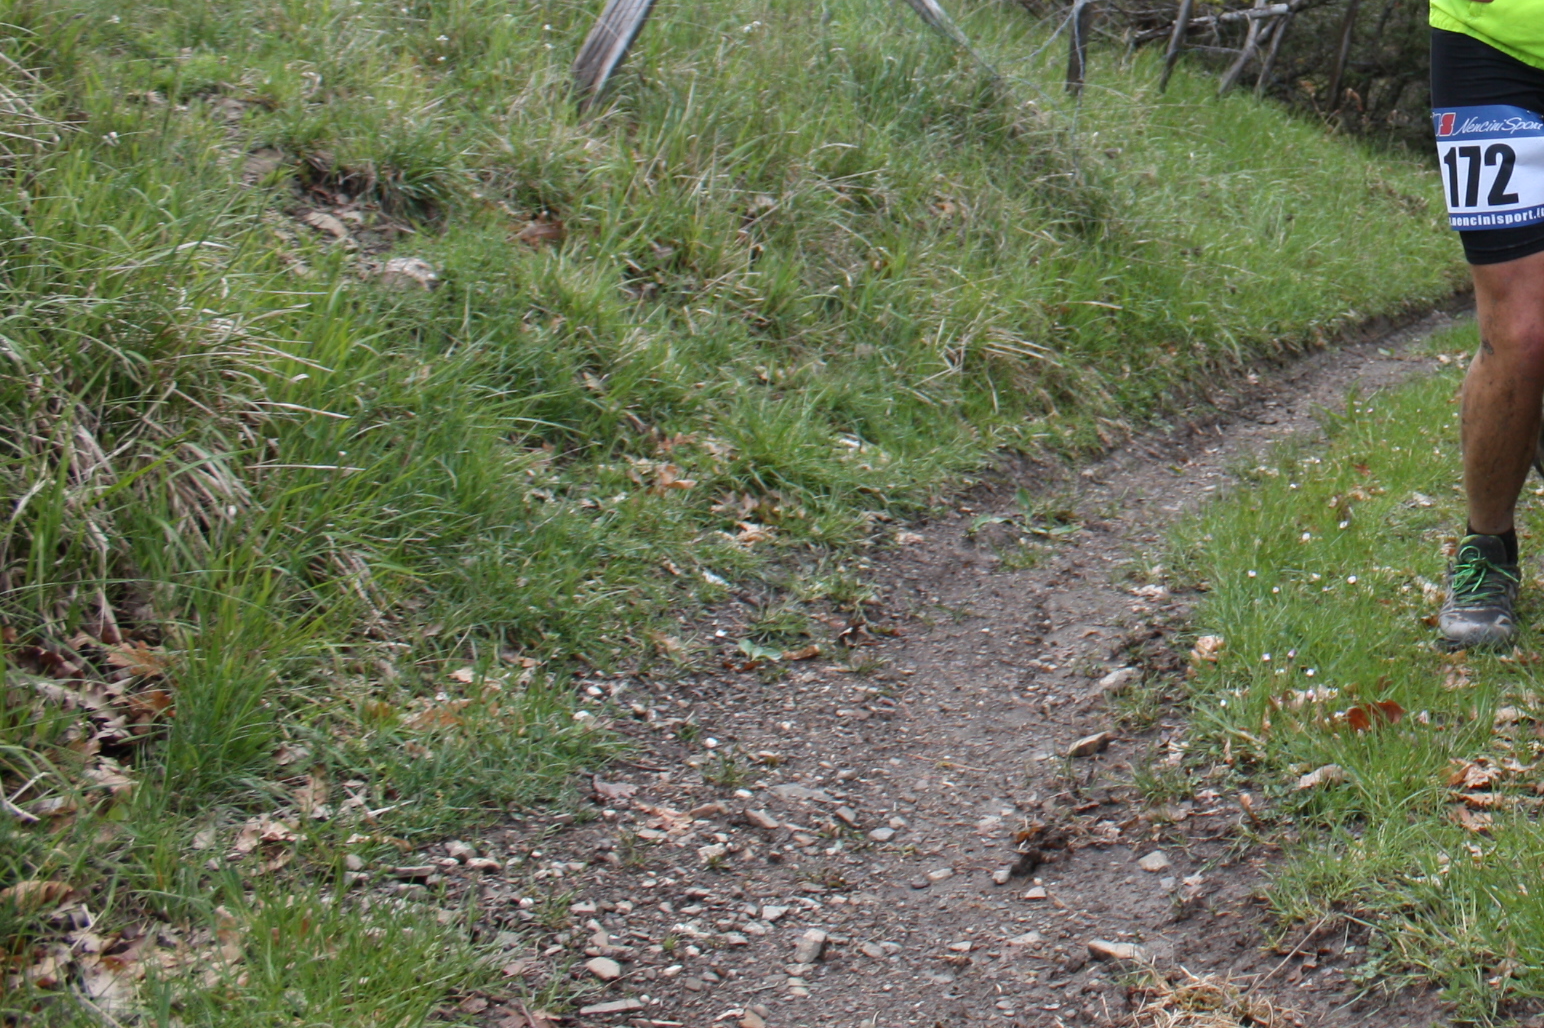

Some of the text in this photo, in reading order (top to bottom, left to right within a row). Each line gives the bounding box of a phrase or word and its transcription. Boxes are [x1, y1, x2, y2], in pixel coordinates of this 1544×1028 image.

[1452, 116, 1543, 136] Nencini Sport
[1443, 143, 1519, 208] 172
